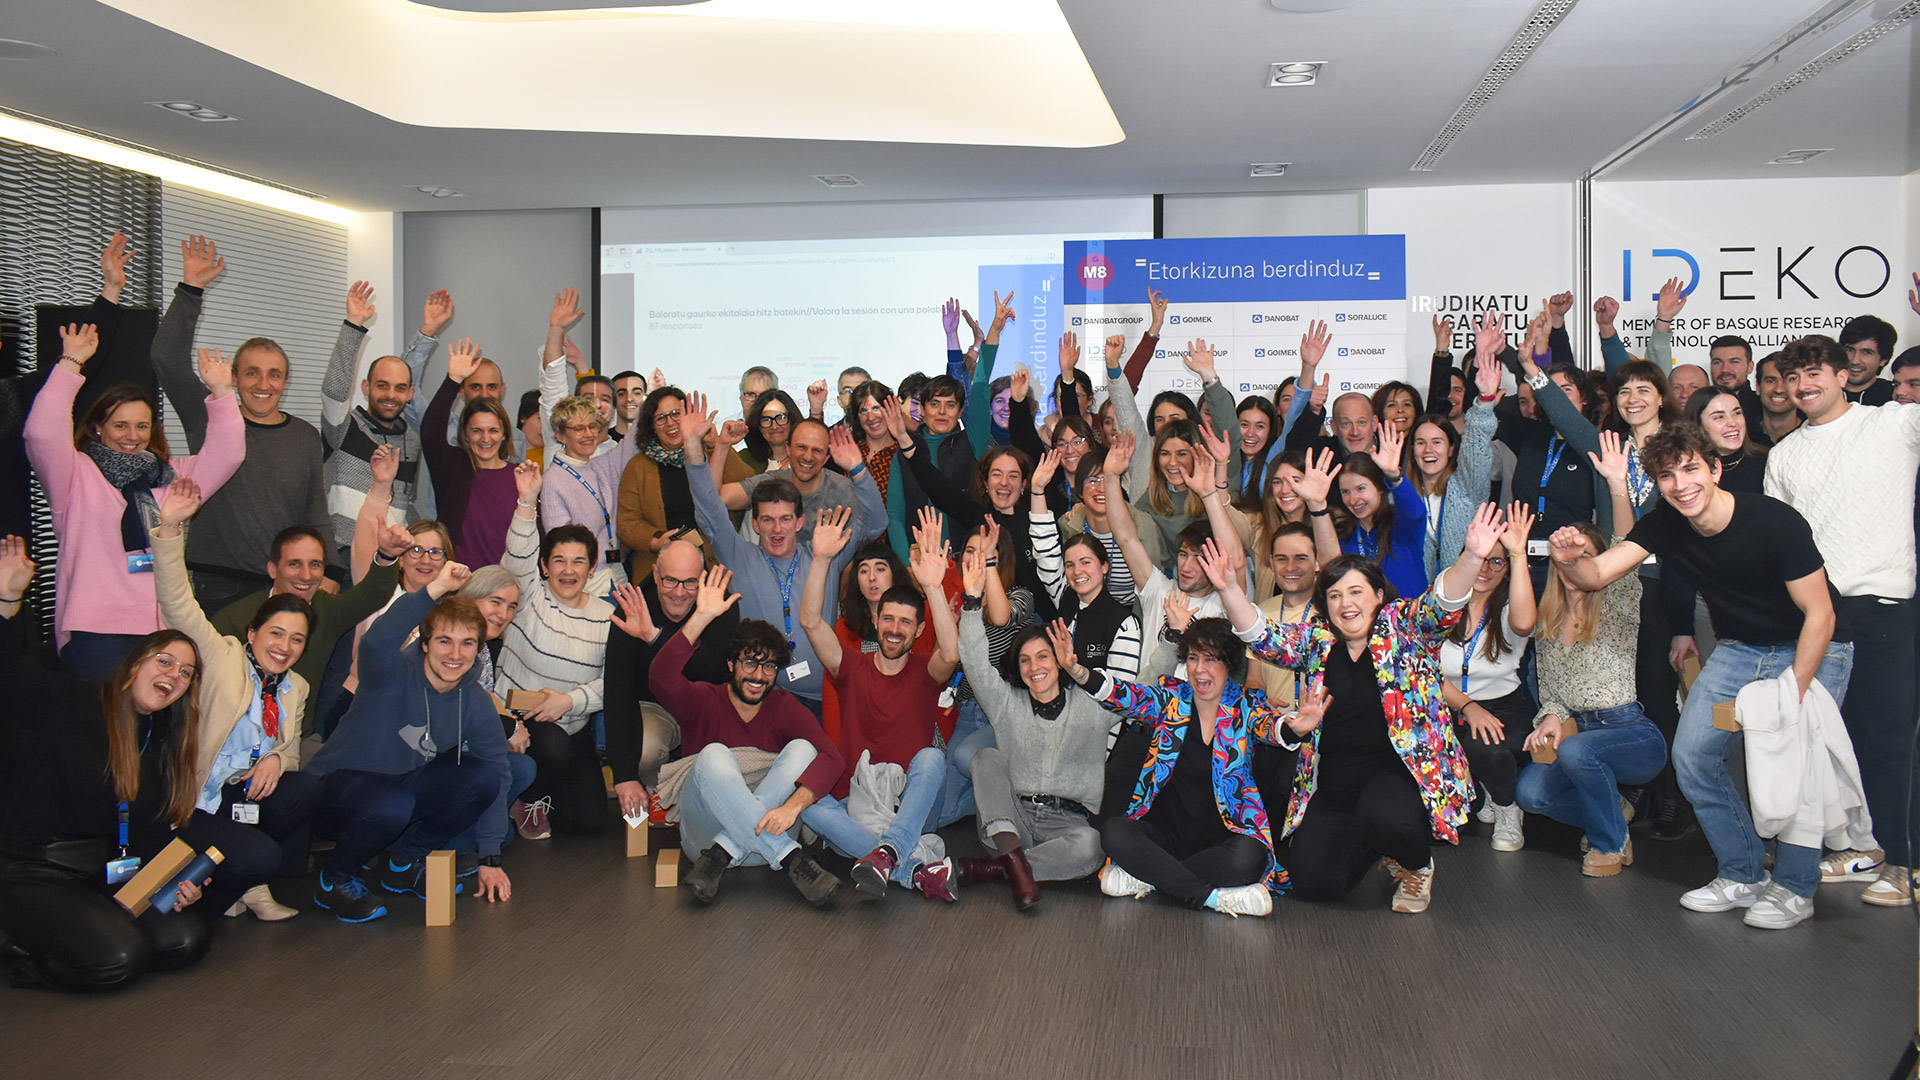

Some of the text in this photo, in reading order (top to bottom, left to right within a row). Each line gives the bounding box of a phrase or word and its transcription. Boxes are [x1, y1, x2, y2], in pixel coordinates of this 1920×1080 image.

[1083, 265, 1107, 279] M8
[1149, 259, 1365, 281] Etorkizuna berdinduz
[1623, 245, 1891, 301] IDEKO
[1412, 294, 1528, 312] IRUDIKATU
[649, 309, 686, 319] Baloratu
[687, 309, 717, 319] gaurko
[718, 307, 755, 317] ekitaldia
[756, 306, 772, 317] hitz
[841, 305, 850, 315] la
[851, 305, 879, 315] sesión
[880, 306, 897, 314] con
[898, 306, 915, 314] una
[916, 304, 942, 316] palab
[1083, 317, 1144, 325] DANOBATGROUP
[1182, 316, 1213, 324] GOIMEK
[1622, 316, 1855, 331] MEMR OF BASQUE RESEARC
[649, 321, 703, 331] 87 responses
[1748, 334, 1802, 347] ALLIAN
[1167, 350, 1228, 358] DANOOUP
[1267, 349, 1298, 357] GOIMEK
[1350, 348, 1386, 356] DANOBAT
[1172, 378, 1202, 388] IDEK
[1252, 383, 1279, 391] DANOB
[1086, 643, 1107, 652] IDEO
